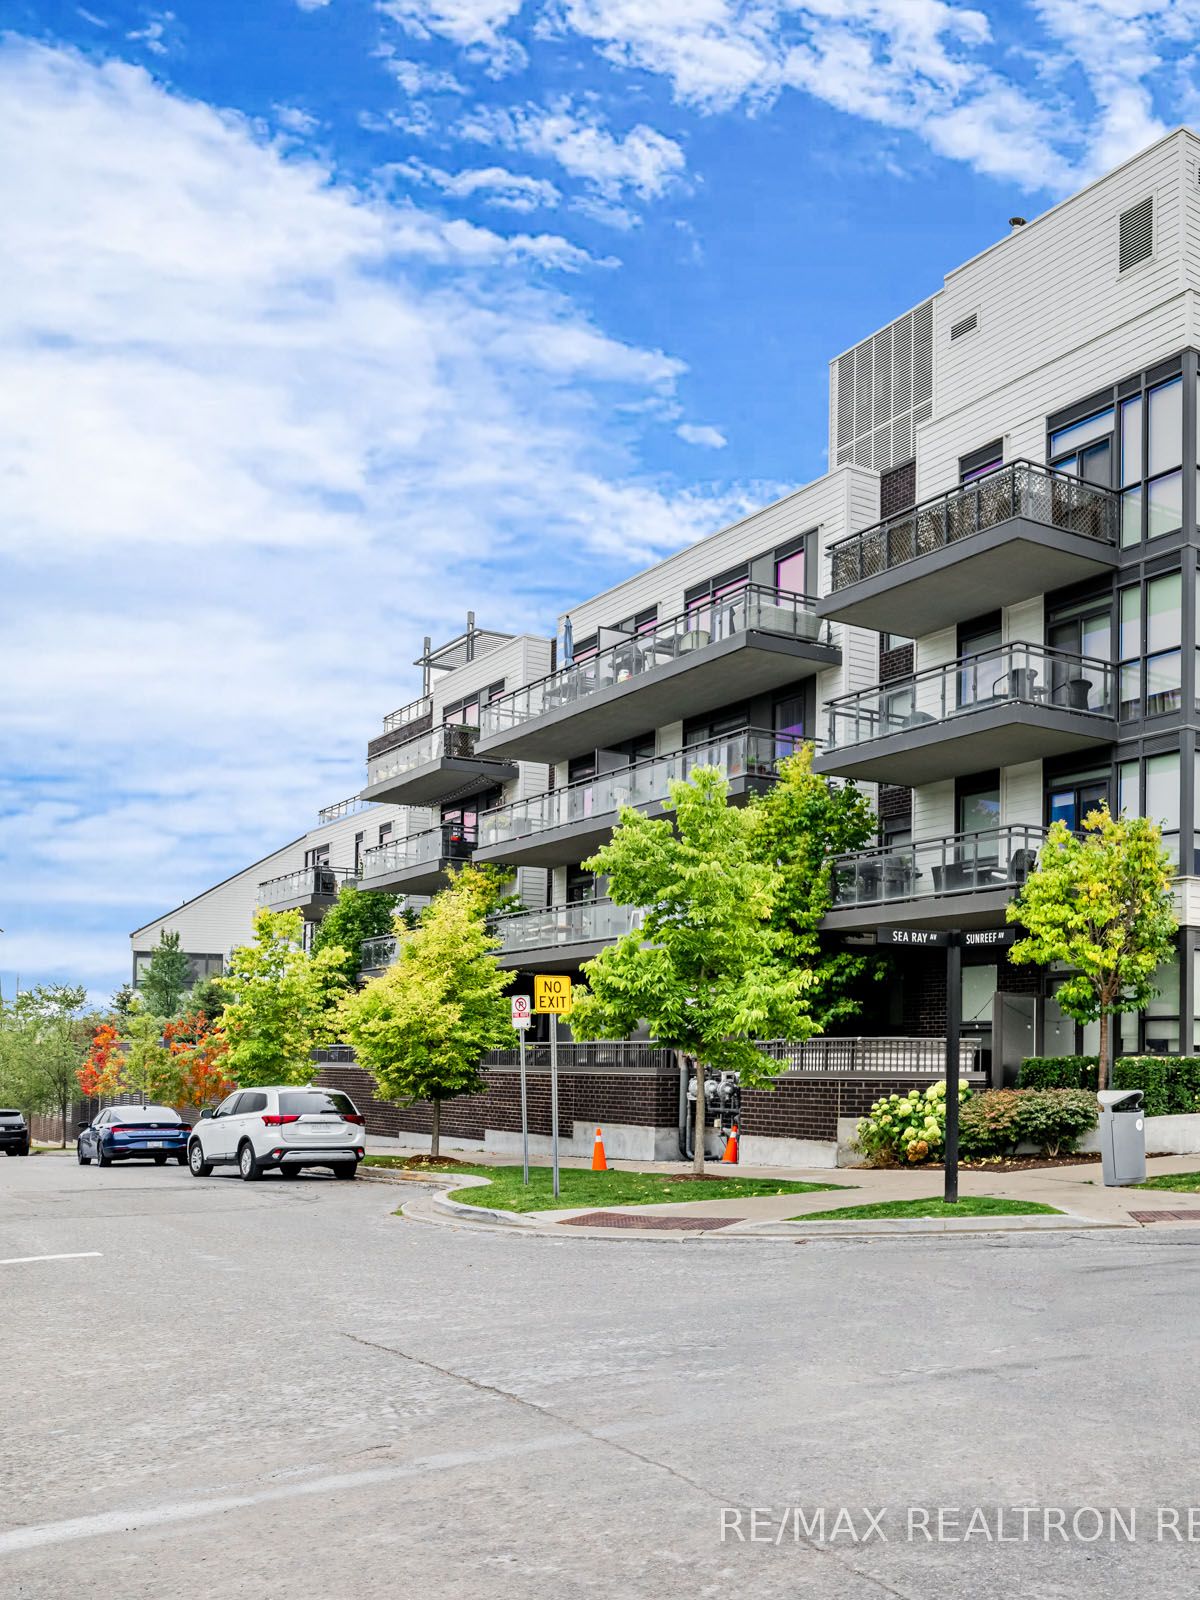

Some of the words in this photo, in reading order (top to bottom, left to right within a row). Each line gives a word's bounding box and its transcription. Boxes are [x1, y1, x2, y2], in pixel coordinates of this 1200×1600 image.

[892, 930, 909, 942] SEA
[911, 932, 928, 944] RAY
[966, 932, 997, 945] SUNREEF
[544, 981, 562, 993] NO
[540, 996, 566, 1008] EXIT
